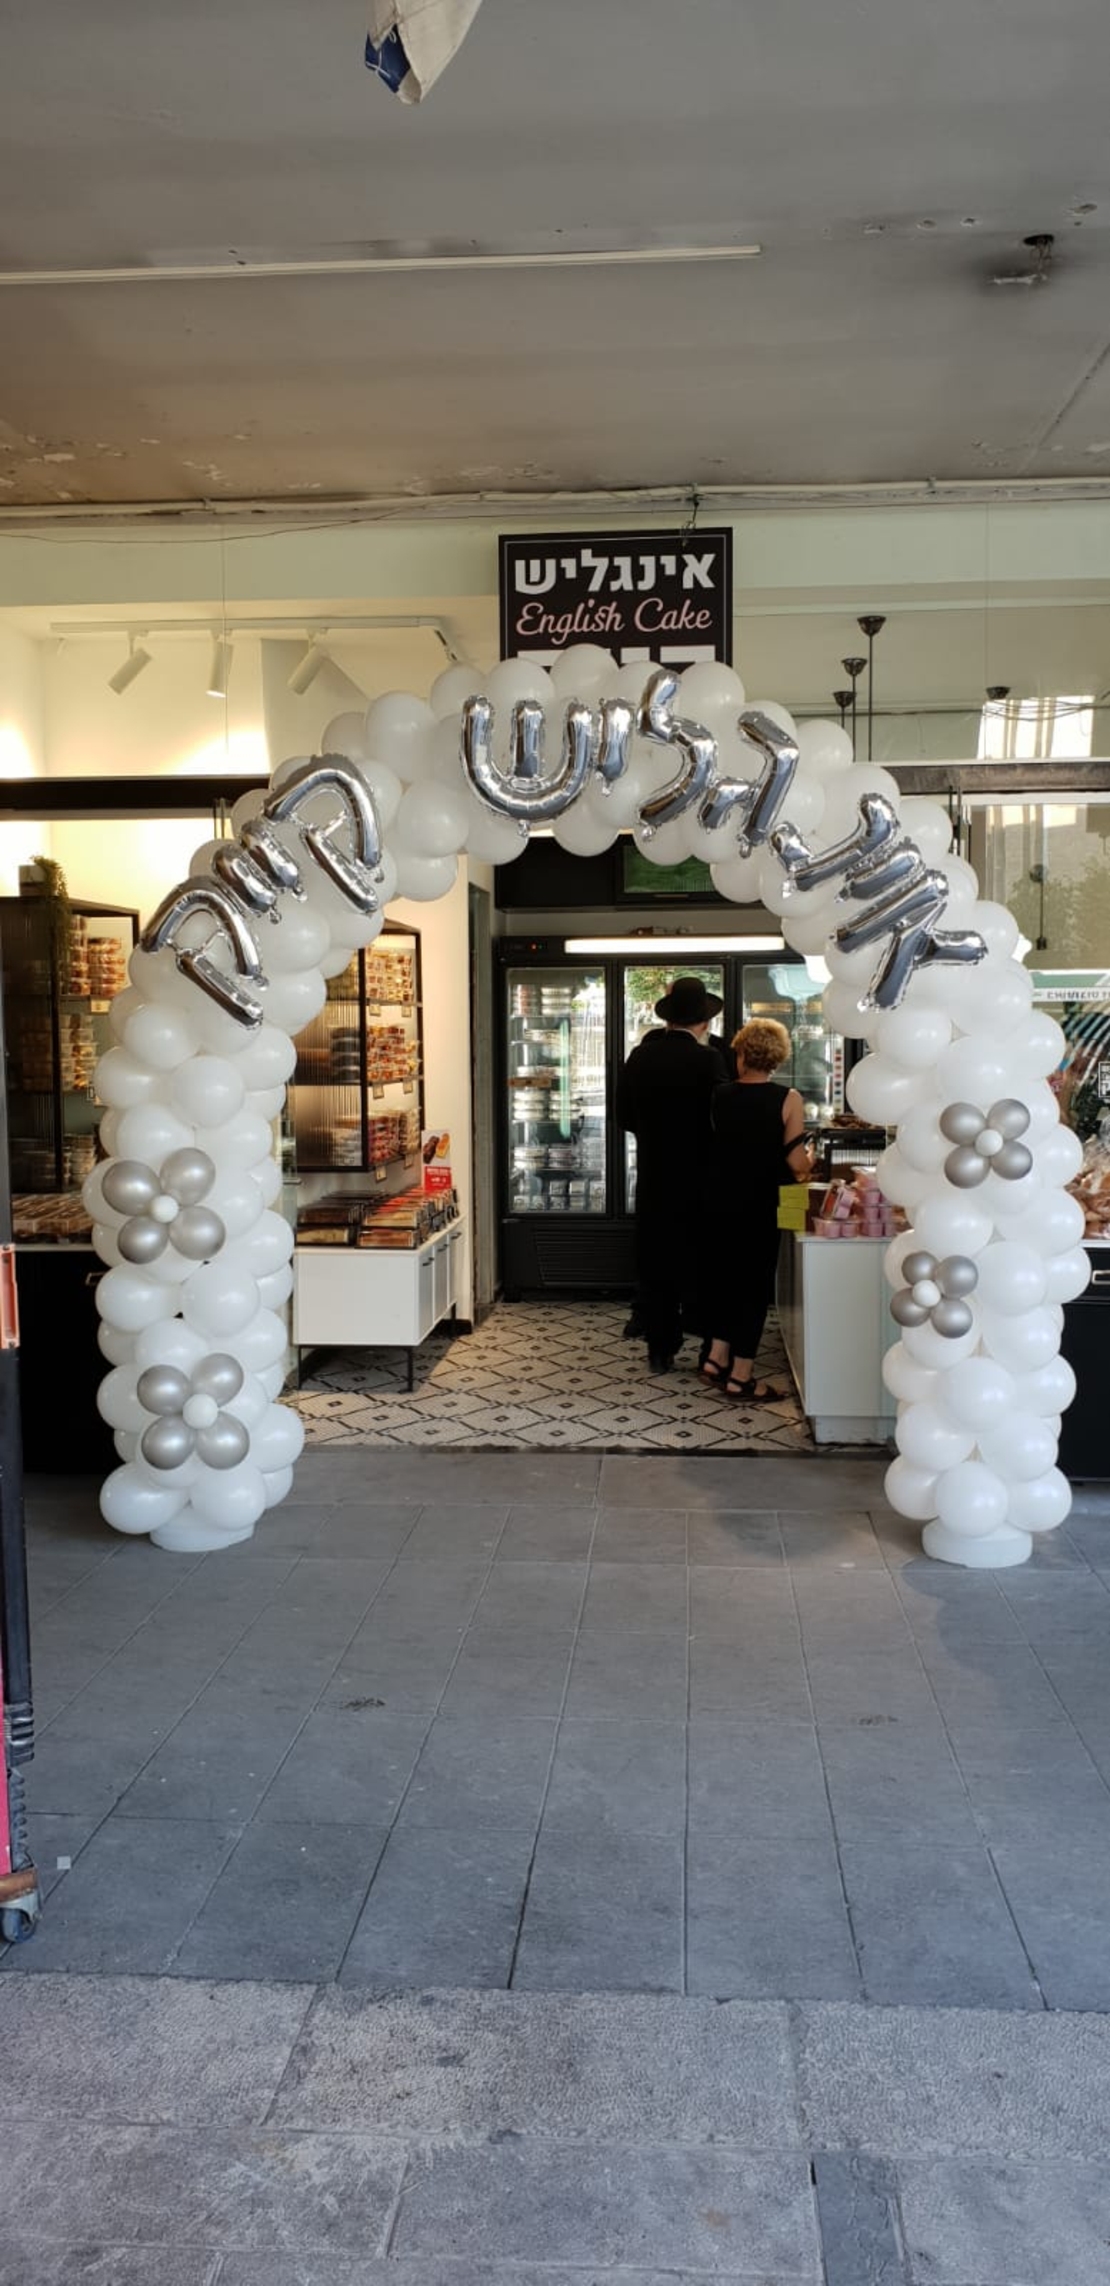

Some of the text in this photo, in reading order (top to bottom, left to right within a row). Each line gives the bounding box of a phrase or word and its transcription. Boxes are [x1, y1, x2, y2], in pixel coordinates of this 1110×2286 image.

[515, 549, 715, 594] אינגליש
[516, 598, 712, 645] English Cake
[140, 669, 988, 1029] אינגליש קייק
